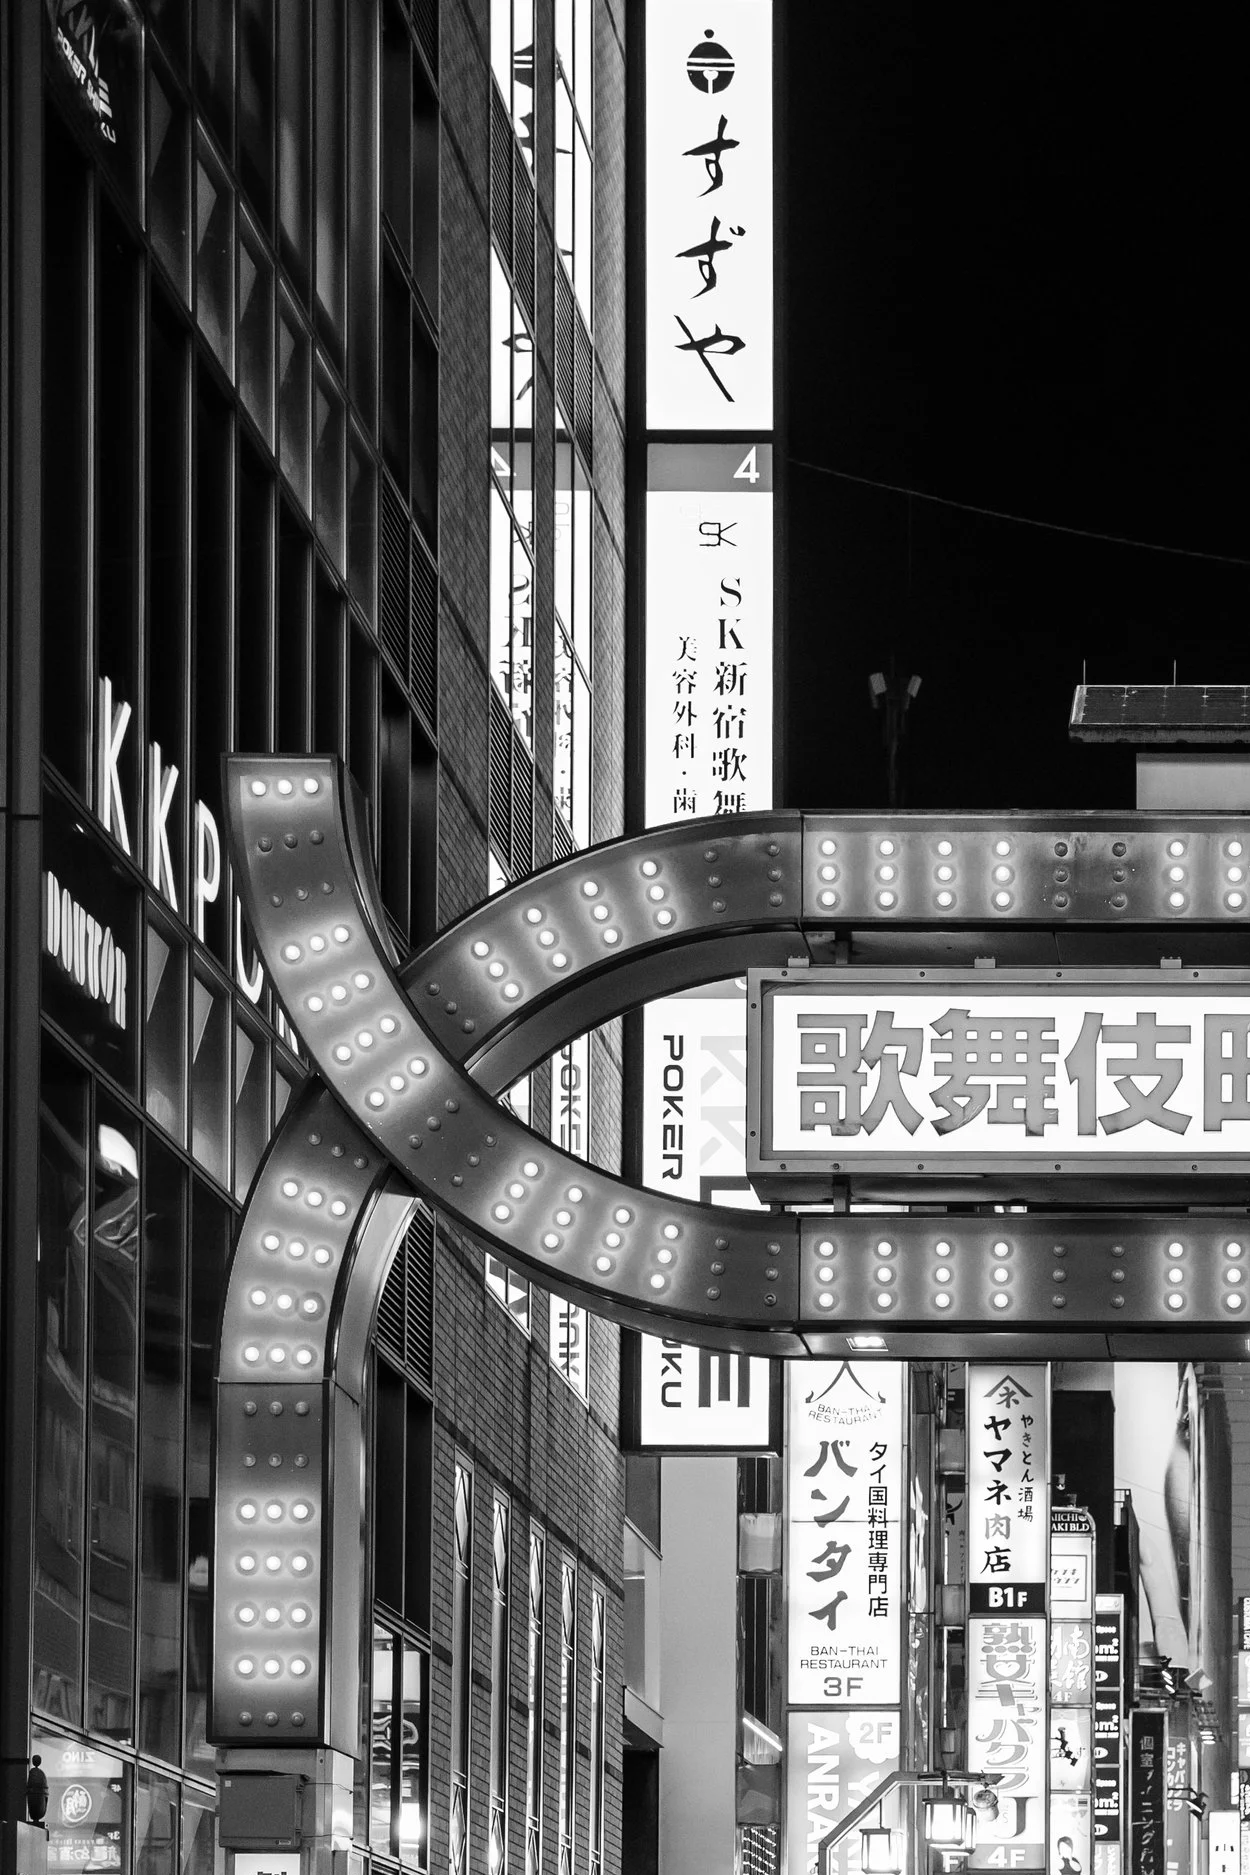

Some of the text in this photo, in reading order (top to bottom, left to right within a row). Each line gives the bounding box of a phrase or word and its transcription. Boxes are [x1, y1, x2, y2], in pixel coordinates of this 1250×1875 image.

[673, 115, 747, 404] すずや
[662, 1033, 684, 1181] POKER
[980, 1414, 1014, 1576] ヤマネ肉店
[1017, 1413, 1036, 1523] やきとん酒場
[803, 1439, 859, 1632] バンタイ
[867, 1441, 889, 1618] タイ国料理専門店
[988, 1586, 1029, 1608] B1F
[799, 1658, 889, 1670] RESTAURANT
[810, 1645, 880, 1657] BAN-THAI
[822, 1676, 865, 1698] 3F
[858, 1721, 893, 1744] 2F
[986, 1845, 1026, 1868] 4F
